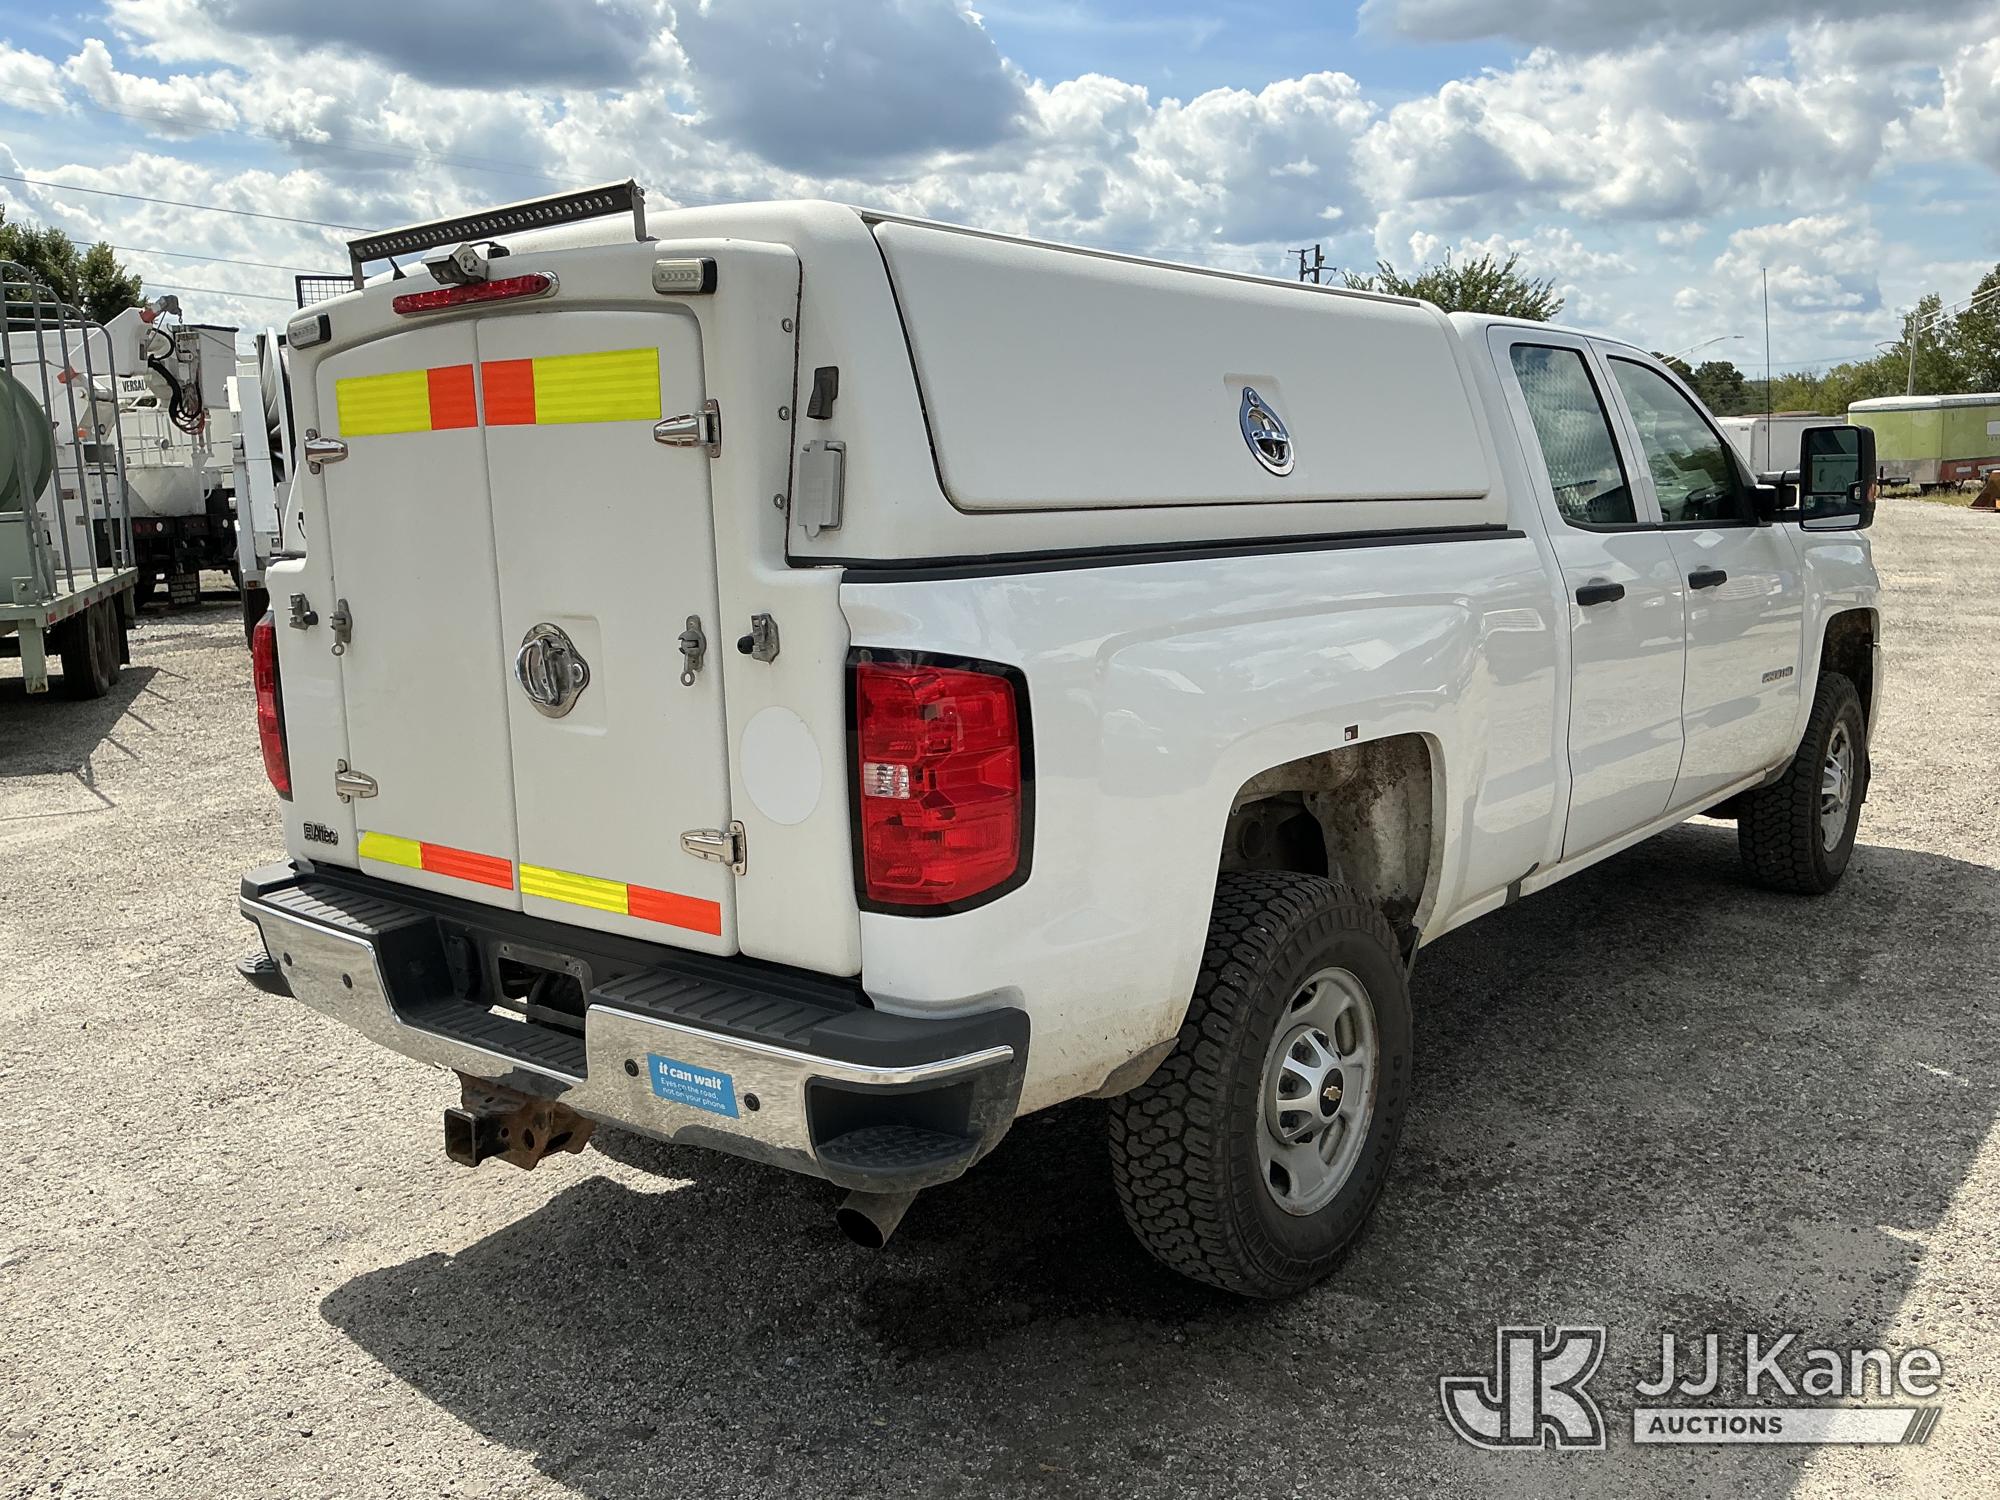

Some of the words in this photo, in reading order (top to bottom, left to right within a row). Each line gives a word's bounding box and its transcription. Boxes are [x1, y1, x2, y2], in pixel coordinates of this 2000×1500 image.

[122, 379, 147, 393] VERSAL
[658, 1061, 668, 1075] it
[670, 1068, 692, 1082] can
[694, 1074, 722, 1090] wait
[661, 1077, 677, 1088] Eyes
[677, 1082, 687, 1091] on
[687, 1085, 699, 1095] the
[662, 1087, 675, 1096] not
[675, 1089, 685, 1097] on
[685, 1093, 701, 1103] your
